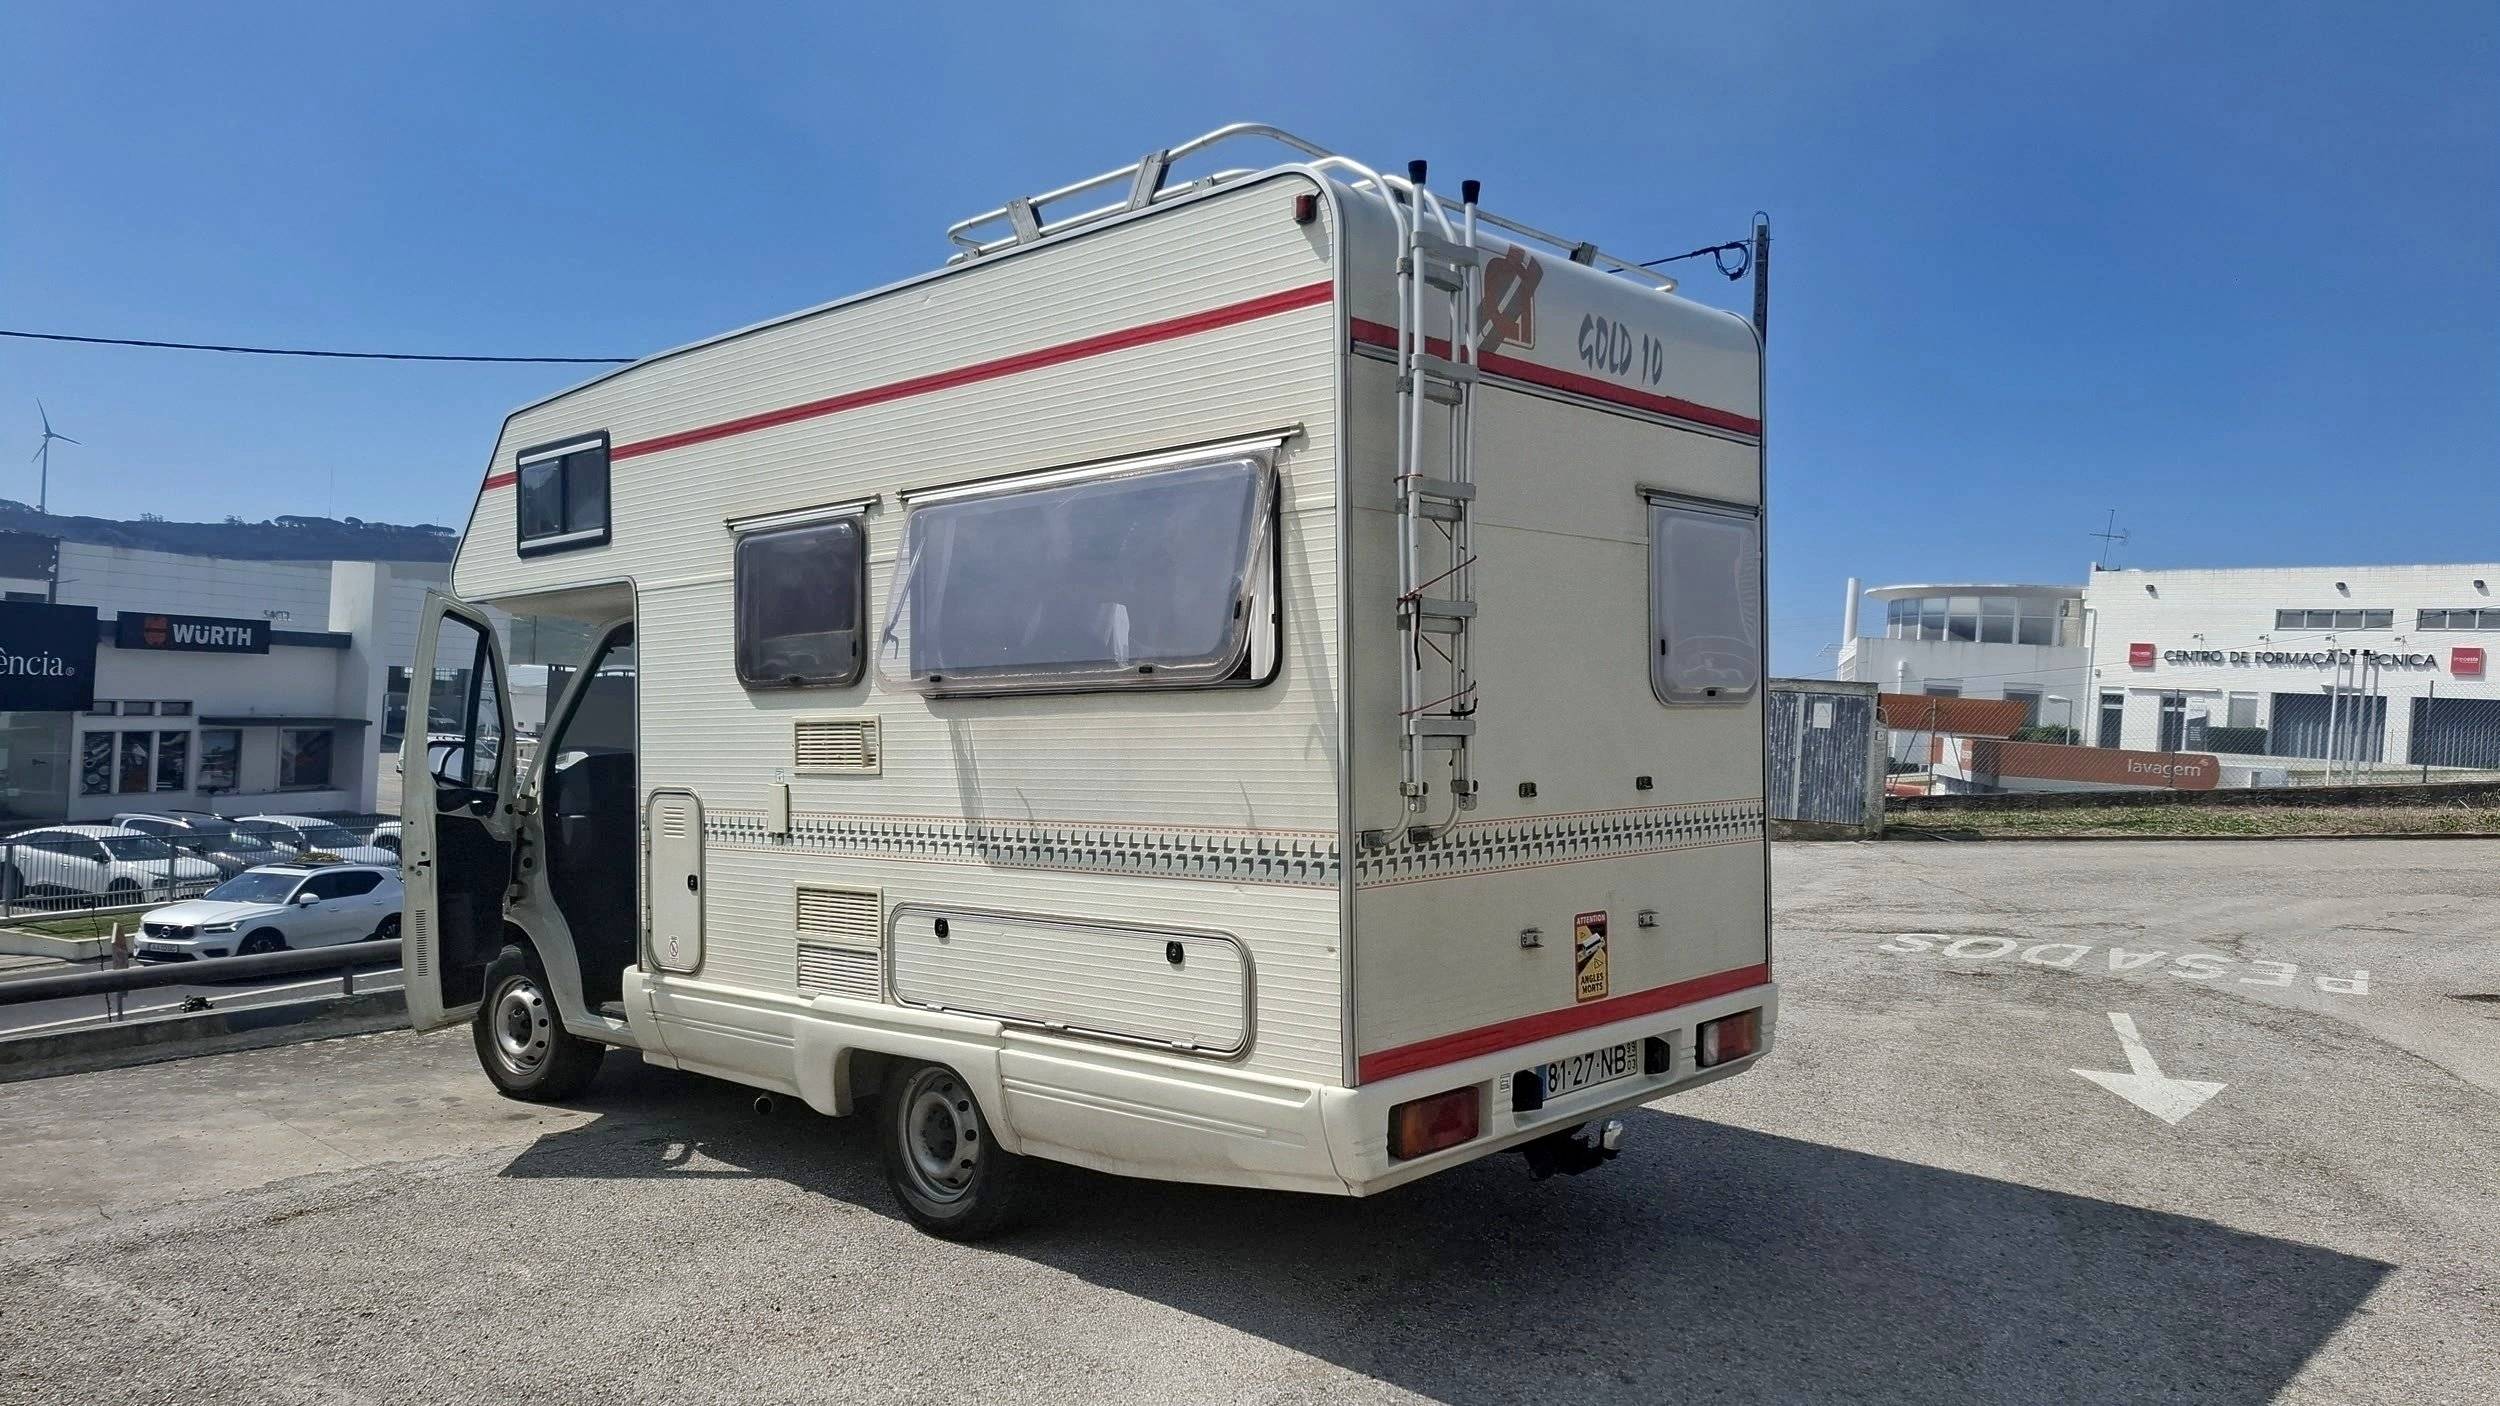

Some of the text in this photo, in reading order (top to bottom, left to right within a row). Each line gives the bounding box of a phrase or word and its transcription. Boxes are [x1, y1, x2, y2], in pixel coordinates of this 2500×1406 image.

[1578, 312, 1632, 377] GOLD
[172, 623, 252, 646] WÜRTH
[2163, 650, 2223, 663] CENTRO
[2229, 651, 2249, 663] DE
[2127, 758, 2201, 778] lavagem
[1575, 913, 1606, 926] ATTENTION
[1878, 933, 2370, 996] PESADOS
[1580, 971, 1604, 986] ANGLES
[1582, 981, 1603, 995] MORTS
